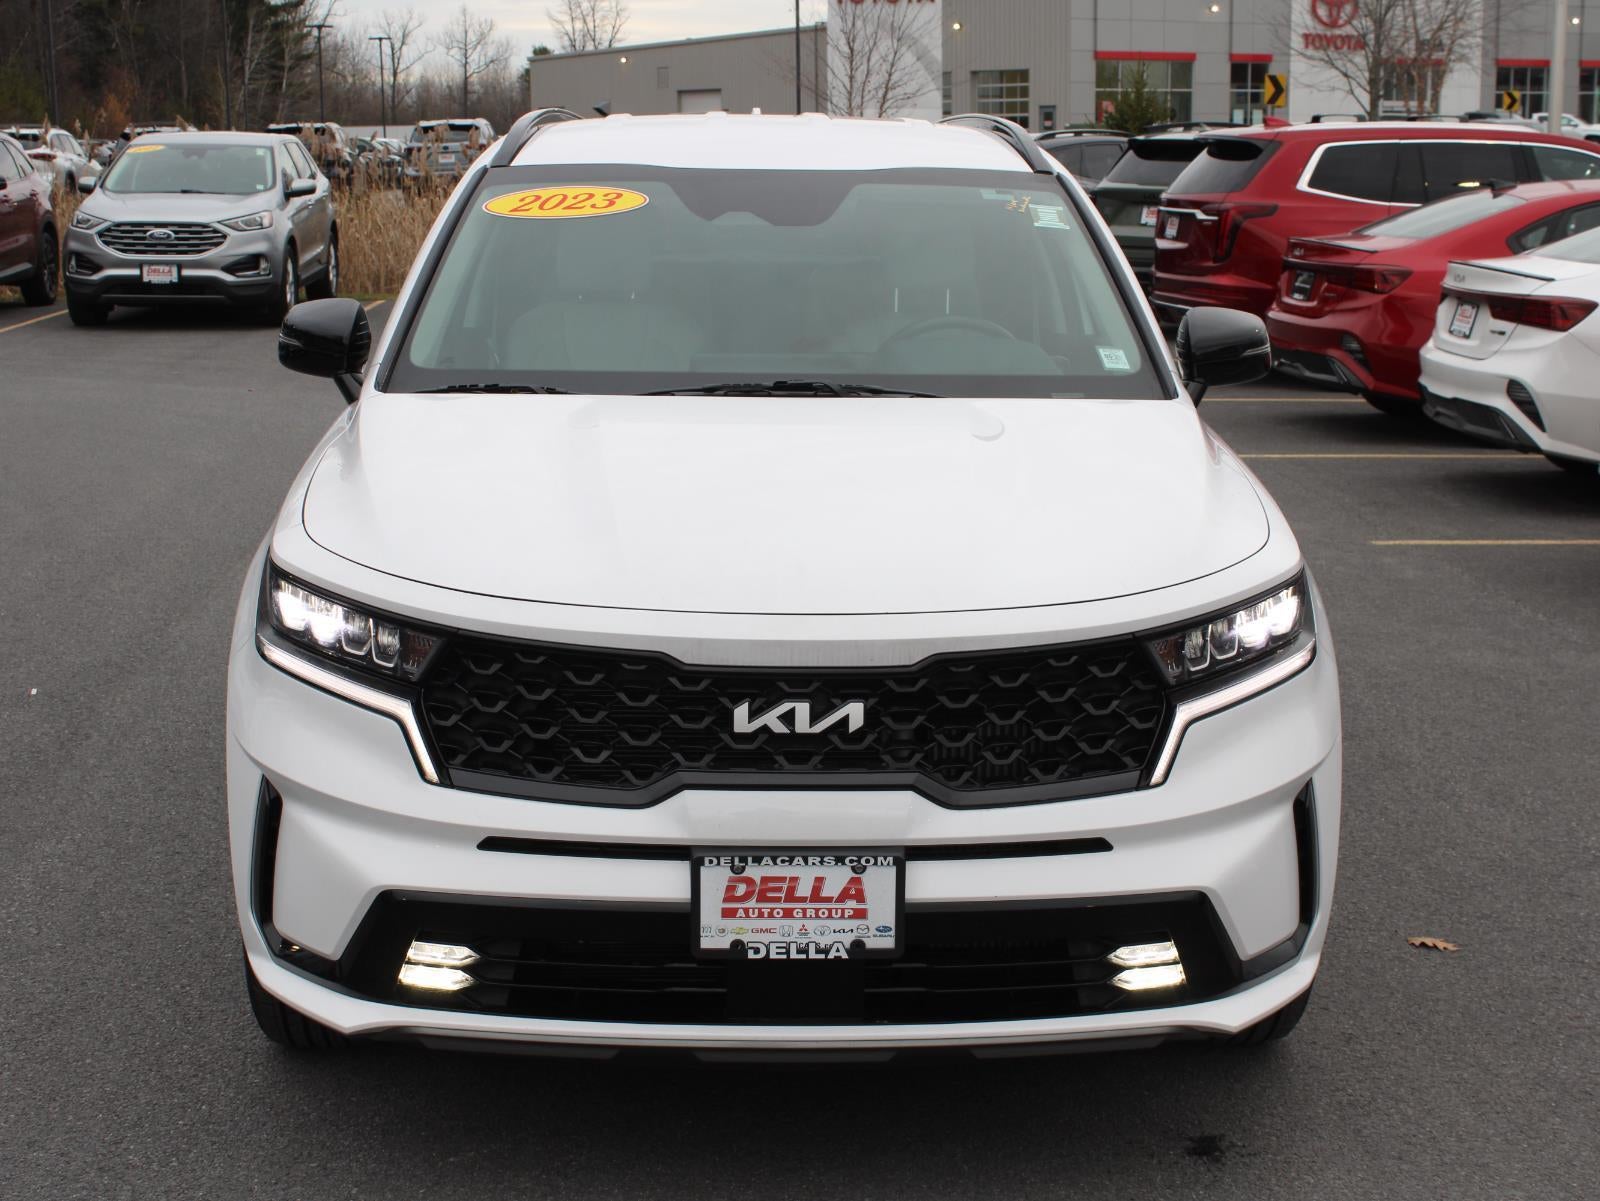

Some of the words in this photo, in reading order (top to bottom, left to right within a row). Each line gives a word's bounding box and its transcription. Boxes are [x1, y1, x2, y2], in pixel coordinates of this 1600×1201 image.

[1302, 33, 1366, 50] TOYOTA
[508, 192, 624, 213] 2023
[733, 701, 864, 734] KIA
[703, 856, 895, 867] DELLACARS.COM
[722, 875, 867, 904] DELLA
[735, 908, 784, 918] AUTO
[792, 908, 854, 918] GROUP
[747, 941, 849, 959] DELLA
